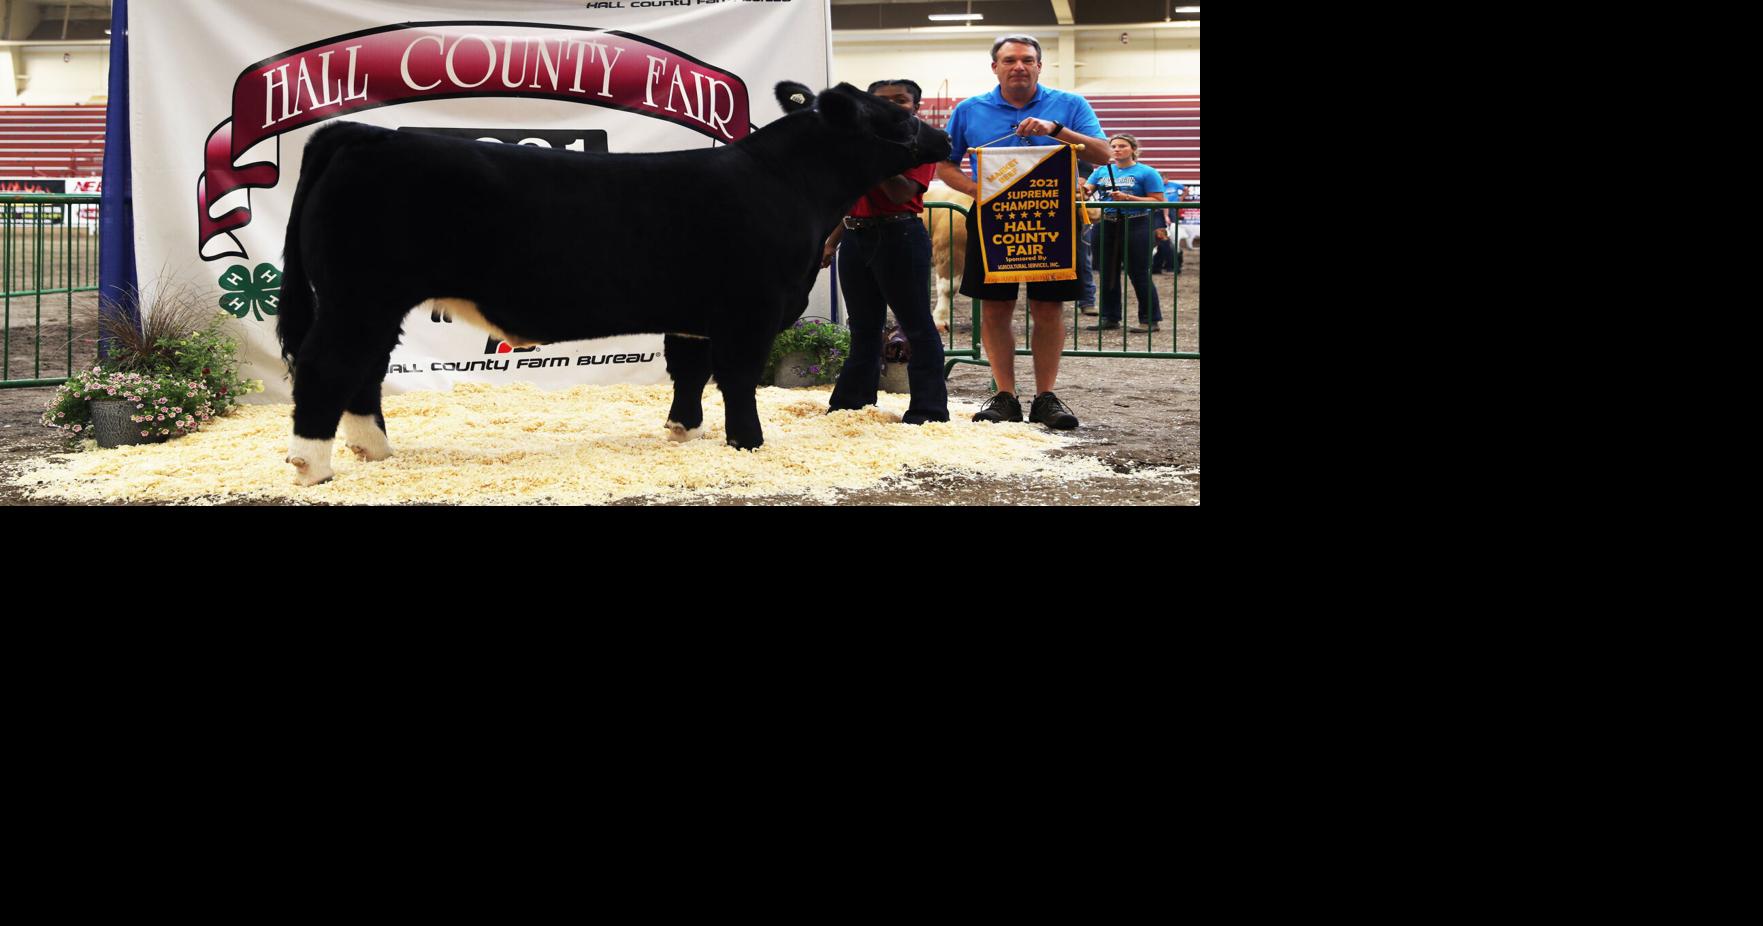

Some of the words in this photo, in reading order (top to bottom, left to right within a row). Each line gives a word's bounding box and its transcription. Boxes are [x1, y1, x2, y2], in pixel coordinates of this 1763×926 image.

[261, 44, 369, 129] HALL
[400, 32, 625, 98] COUNTY
[642, 54, 735, 139] FAIR
[1029, 179, 1058, 188] 2021
[1007, 189, 1059, 200] SUPREME
[992, 199, 1059, 212] CHAMPION
[1004, 220, 1046, 232] HALL
[992, 231, 1060, 245] COUNTY
[1006, 244, 1044, 256] FAIR
[387, 364, 423, 373] ALL
